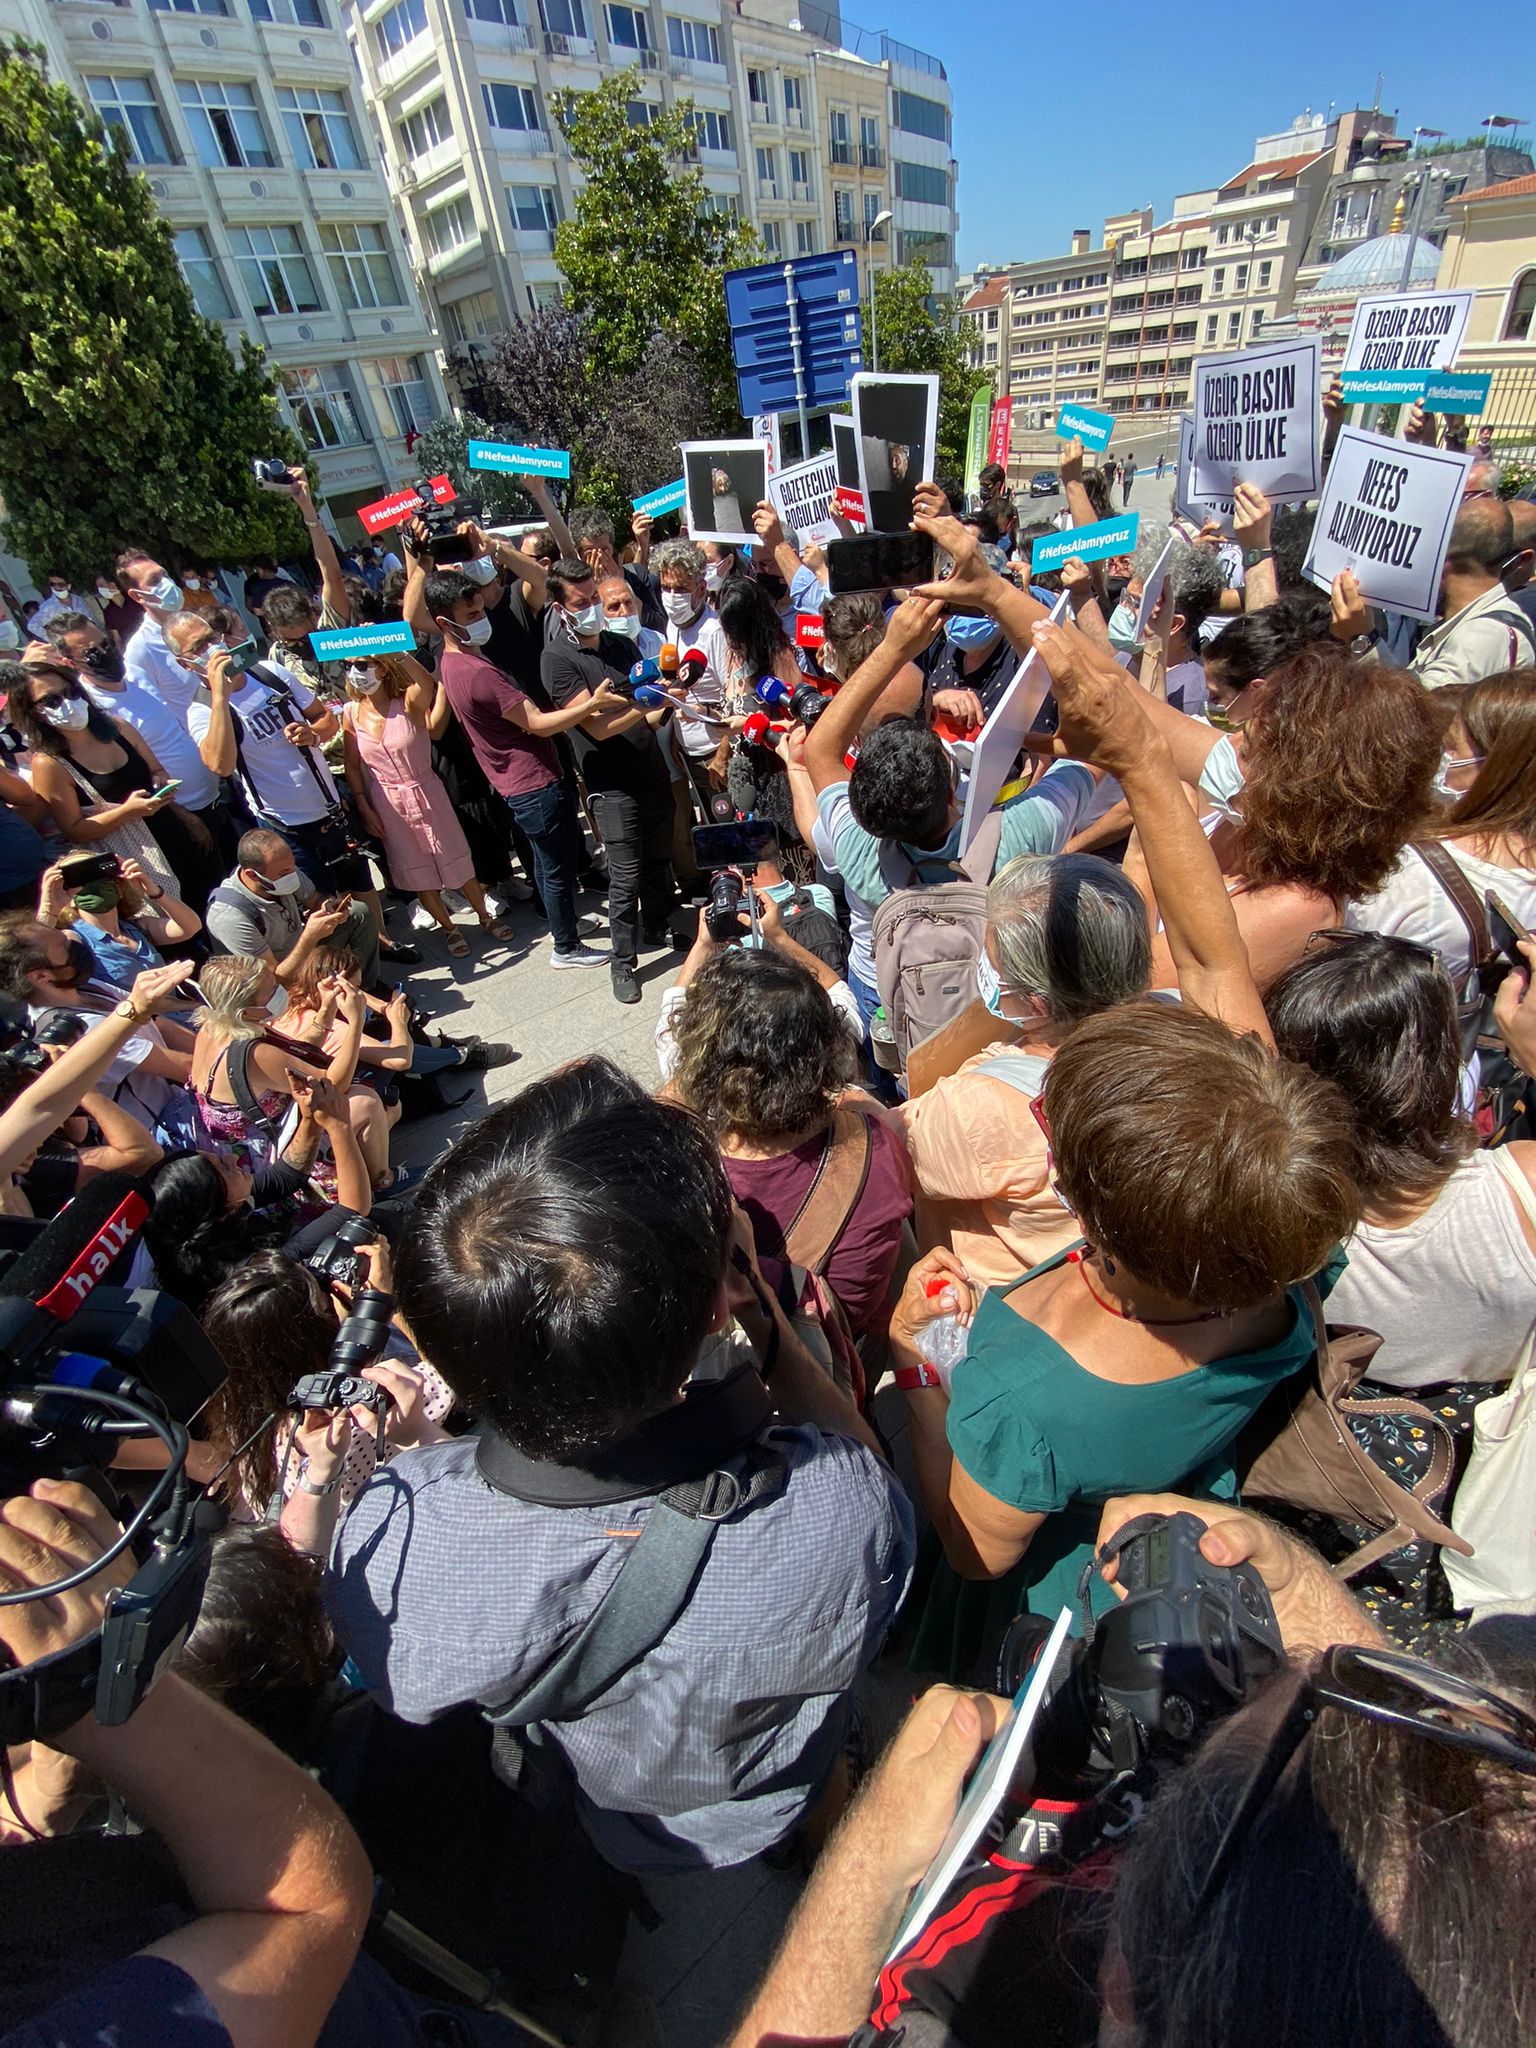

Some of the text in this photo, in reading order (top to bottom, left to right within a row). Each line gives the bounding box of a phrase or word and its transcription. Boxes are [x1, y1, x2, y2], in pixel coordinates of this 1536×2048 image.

[1365, 304, 1457, 340] ÖZGÜR BASIN
[1360, 337, 1440, 371] ÖZGÜR ÜLKE
[1203, 364, 1296, 418] ÖZGÜR BASIN
[1206, 418, 1242, 462] ÖZGÜR
[1245, 416, 1288, 462] ÜLKE
[476, 450, 563, 470] #NefesAlamıyoruz
[780, 464, 839, 506] GAZETECİLİK
[1357, 458, 1409, 513] NEFES
[842, 498, 864, 513] #Nefes
[1039, 530, 1130, 561] #NefesAlamıyoruz
[1327, 500, 1423, 570] ALAMIYORUZ
[319, 633, 407, 651] #NefesAlamıyoruz
[801, 625, 825, 638] #Nefe
[249, 702, 287, 741] LOF
[65, 1217, 134, 1299] halk
